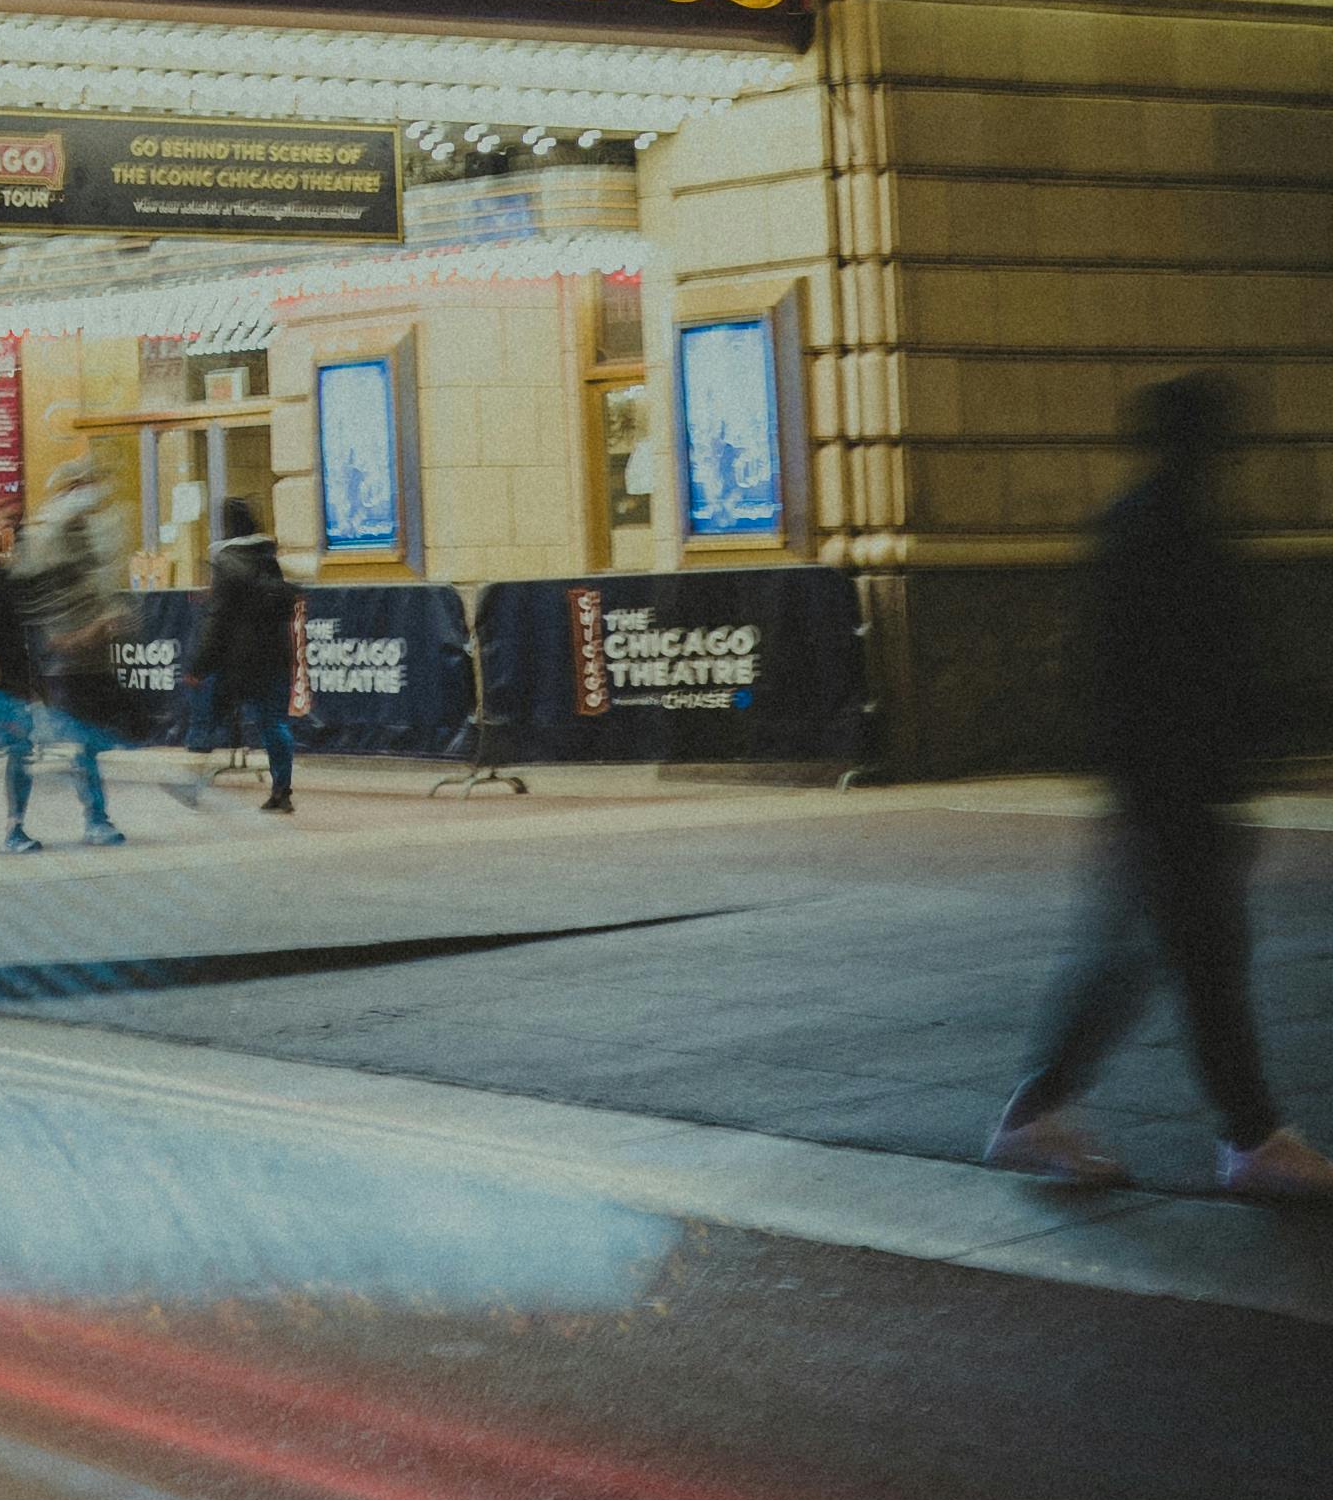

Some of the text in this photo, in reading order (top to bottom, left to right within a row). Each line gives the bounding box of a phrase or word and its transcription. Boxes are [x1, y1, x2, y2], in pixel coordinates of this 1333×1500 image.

[130, 137, 366, 164] GO BEHIND THE SCENES OF
[112, 164, 148, 184] THE
[150, 166, 215, 187] ICONIC
[216, 168, 299, 190] CHICAGO
[1, 188, 50, 208] TOUR
[604, 608, 655, 631] THE
[306, 638, 407, 666] CHICAGO
[604, 625, 760, 659] CHICAGO
[117, 666, 181, 690] EATRE
[306, 665, 407, 693] THEATRE
[607, 655, 761, 687] THEATRE
[661, 690, 731, 709] CHASE
